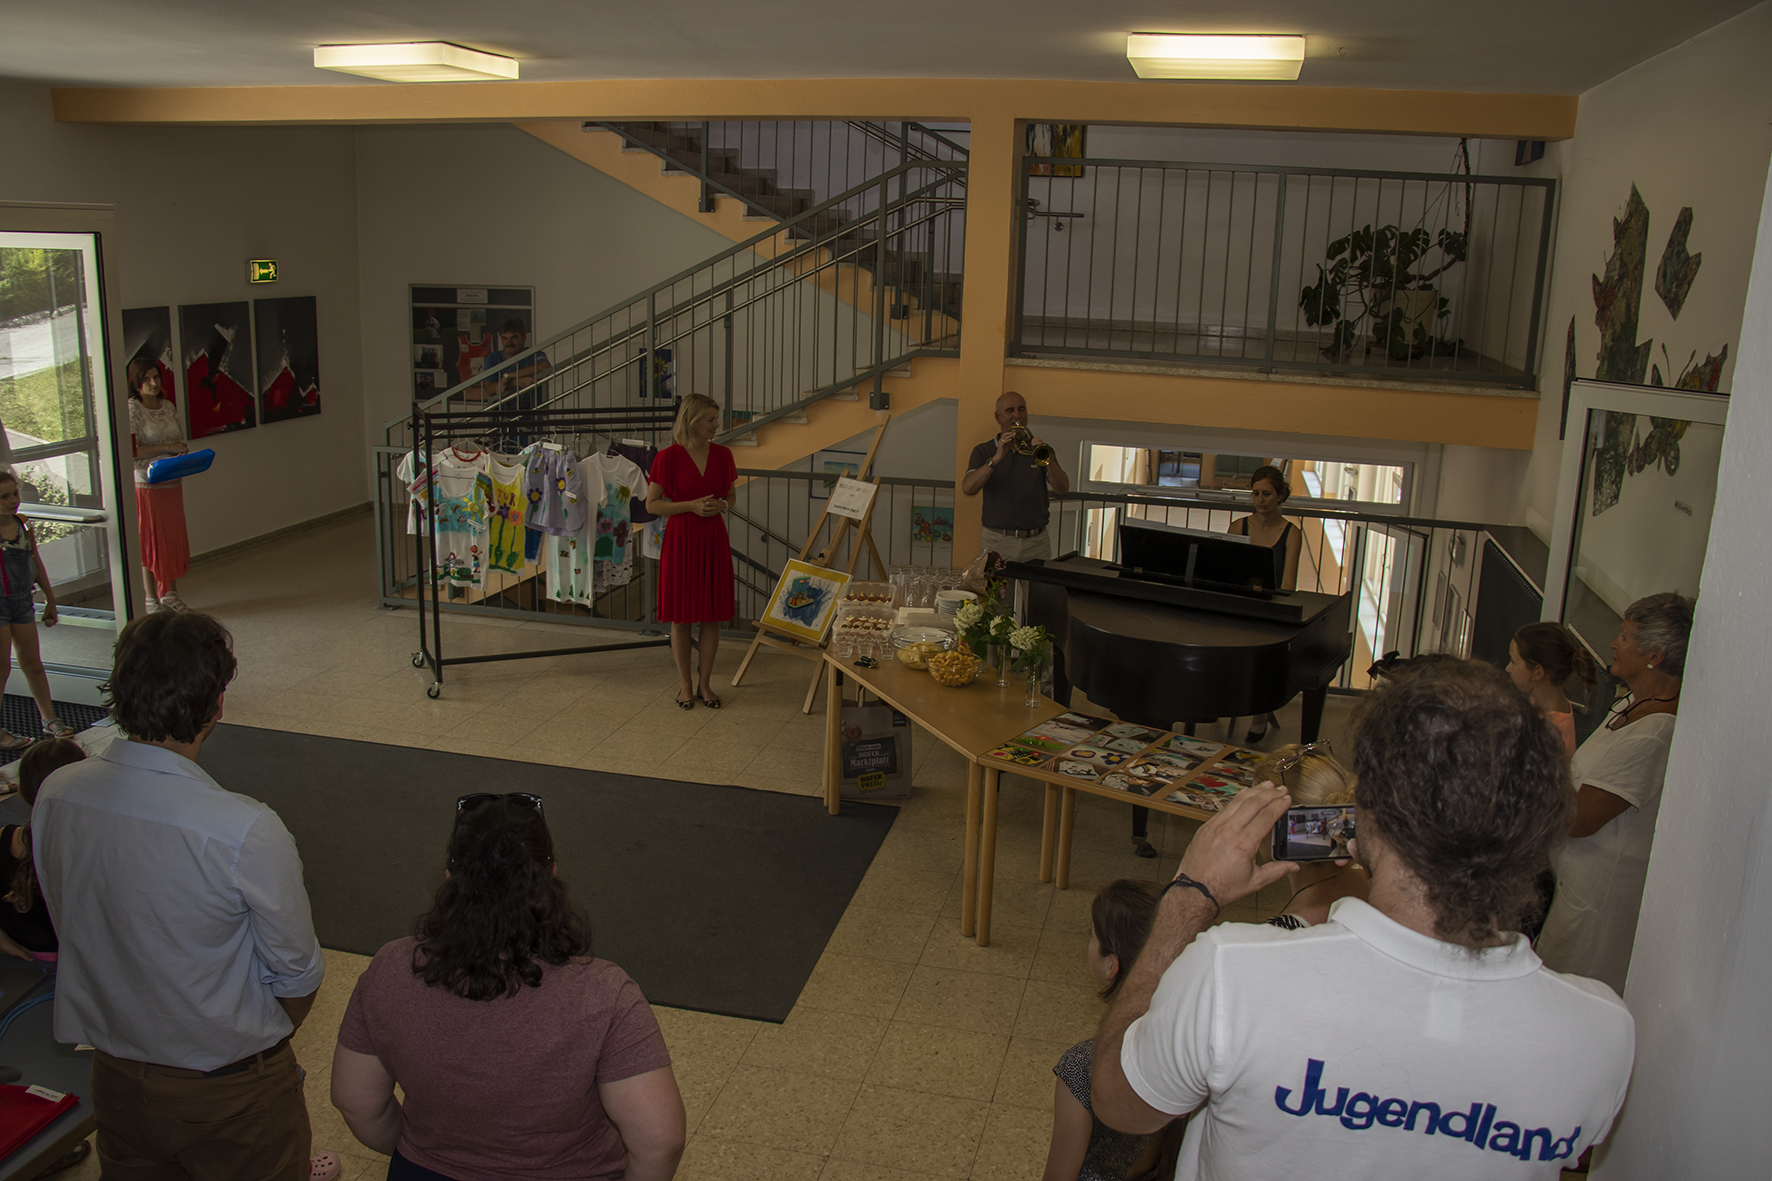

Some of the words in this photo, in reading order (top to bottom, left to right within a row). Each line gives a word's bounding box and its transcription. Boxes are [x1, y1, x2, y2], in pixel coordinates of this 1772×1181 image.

[850, 756, 890, 767] Marktplatz
[861, 774, 883, 782] HOFER
[1275, 1058, 1581, 1161] Jugendland
